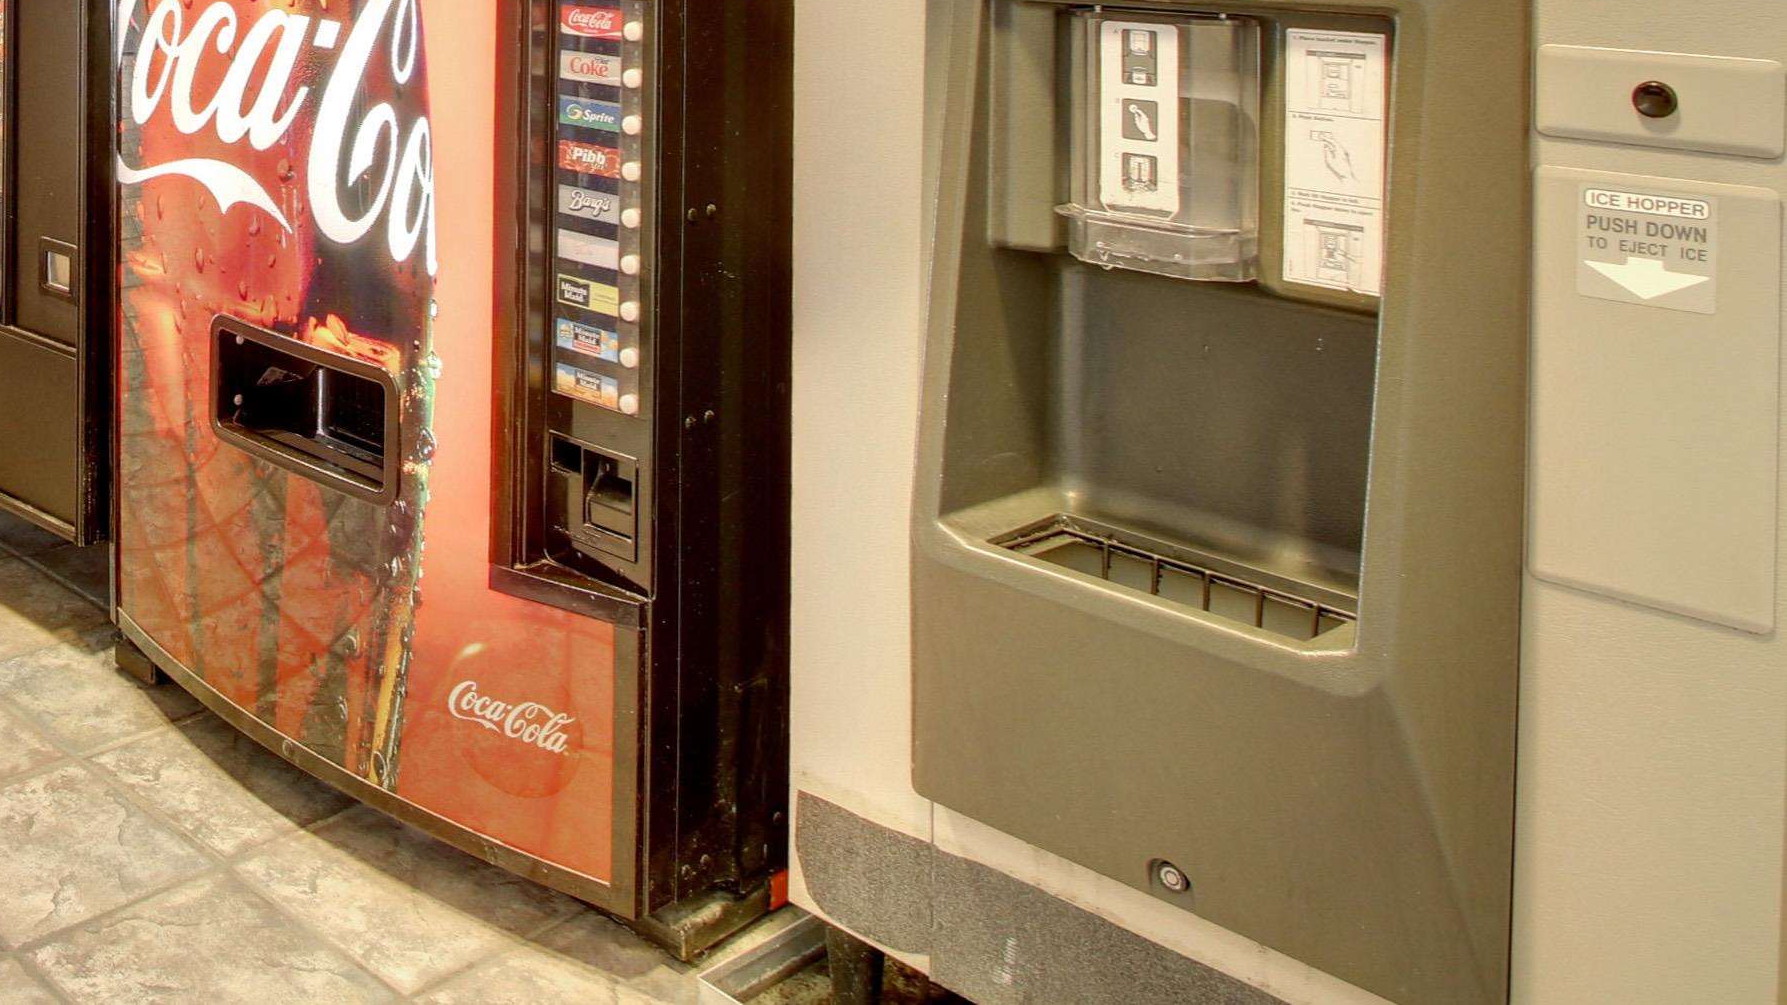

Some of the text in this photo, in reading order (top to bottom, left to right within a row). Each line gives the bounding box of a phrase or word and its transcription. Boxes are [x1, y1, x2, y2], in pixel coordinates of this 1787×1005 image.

[568, 8, 614, 30] Coca-Cola
[570, 56, 609, 78] Coke
[582, 108, 615, 124] Sprite
[572, 145, 607, 165] Pibb
[1590, 192, 1705, 216] ICE HOPPER
[1587, 214, 1707, 243] PUSH DOWN
[1587, 235, 1709, 262] TO EJECT ICE
[448, 680, 576, 754] Coca-Cola
